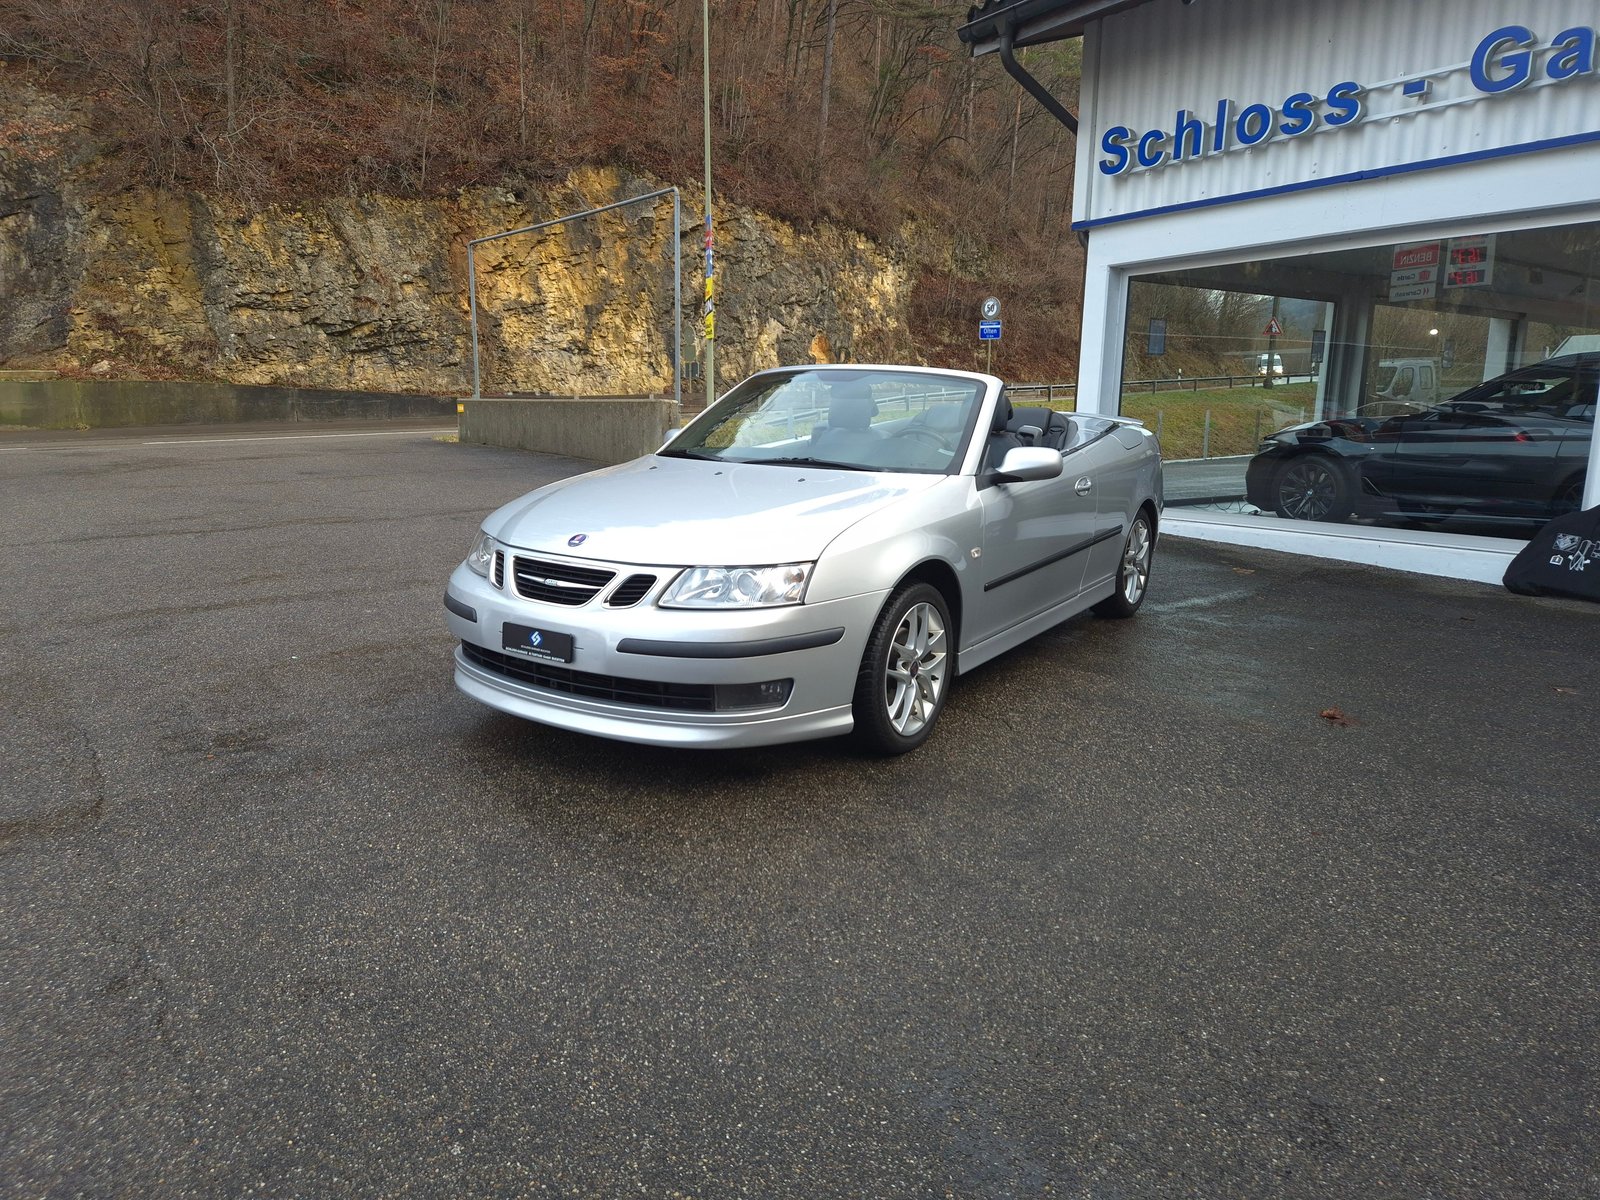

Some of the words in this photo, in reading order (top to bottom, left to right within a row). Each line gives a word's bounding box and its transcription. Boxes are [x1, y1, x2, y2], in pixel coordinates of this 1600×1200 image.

[1099, 81, 1366, 176] Schloss
[1470, 25, 1596, 94] Ga
[986, 304, 995, 313] 50
